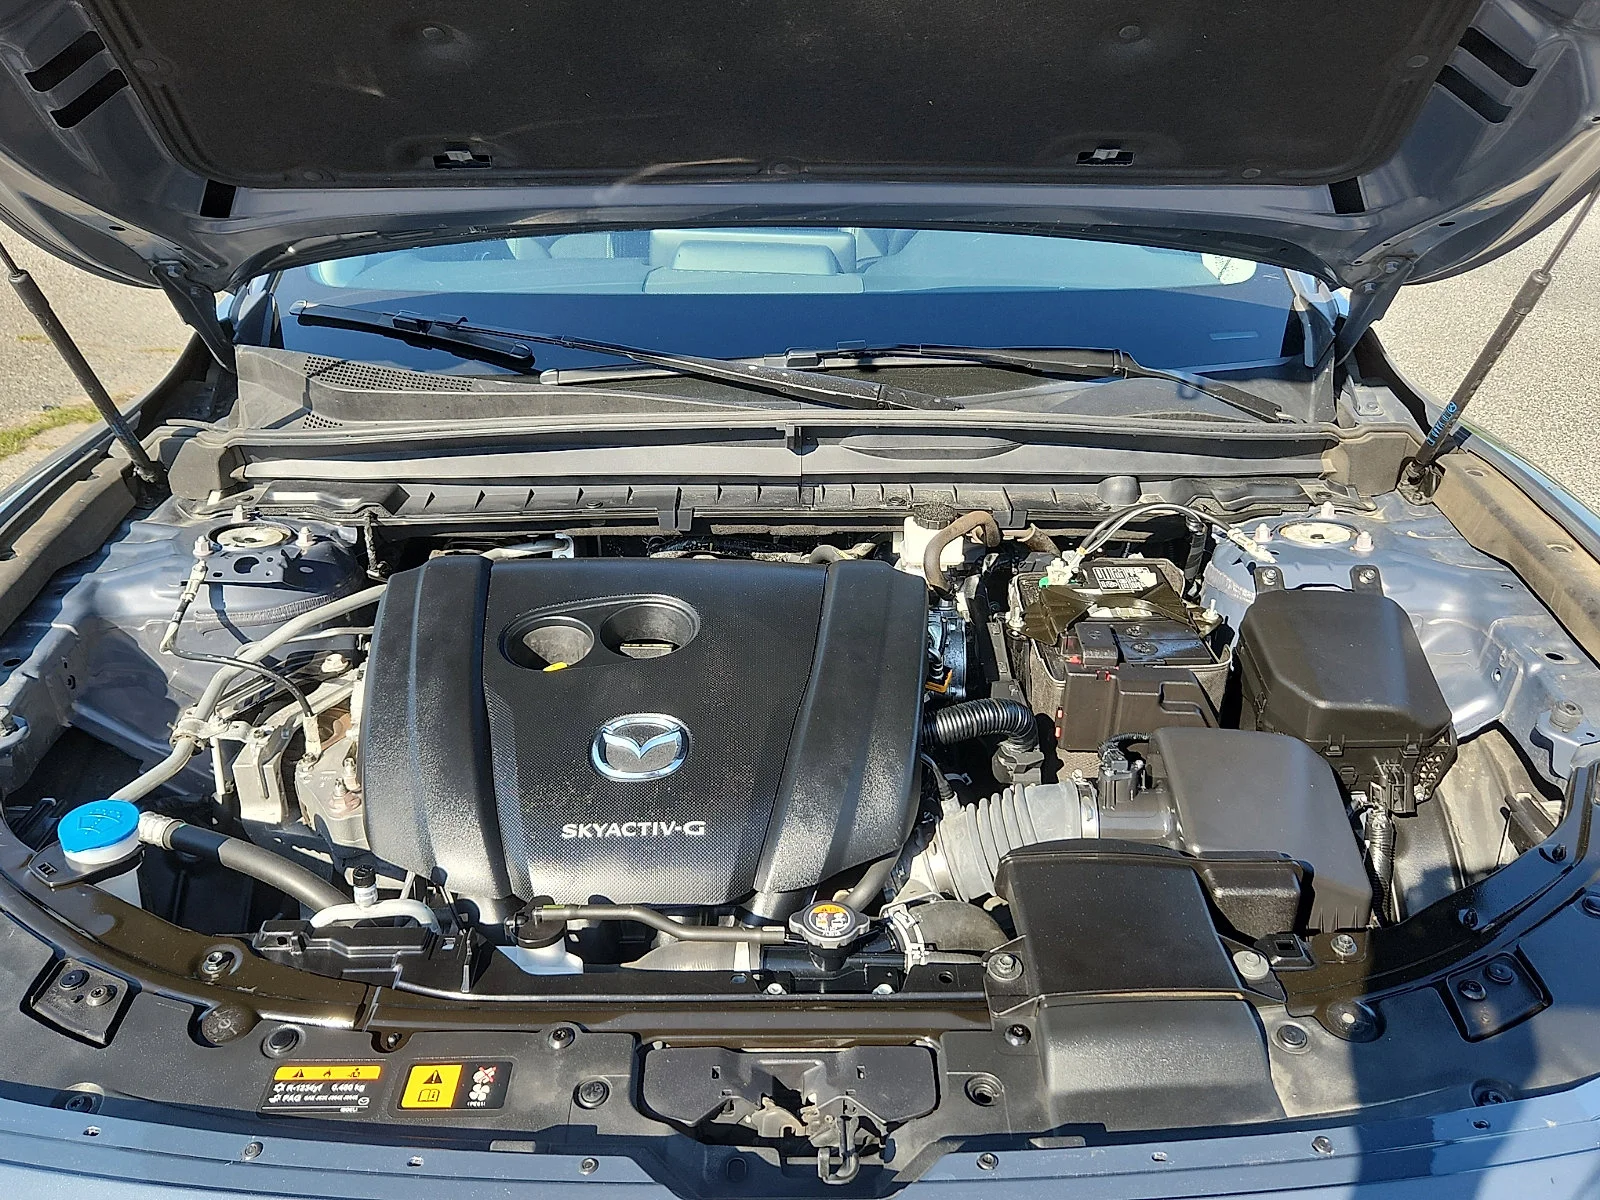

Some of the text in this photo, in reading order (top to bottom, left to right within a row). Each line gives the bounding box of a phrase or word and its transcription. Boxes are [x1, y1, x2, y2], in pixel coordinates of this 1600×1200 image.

[561, 820, 706, 840] SKYACTIV-G
[354, 1083, 365, 1093] kg
[282, 1093, 302, 1103] PAG
